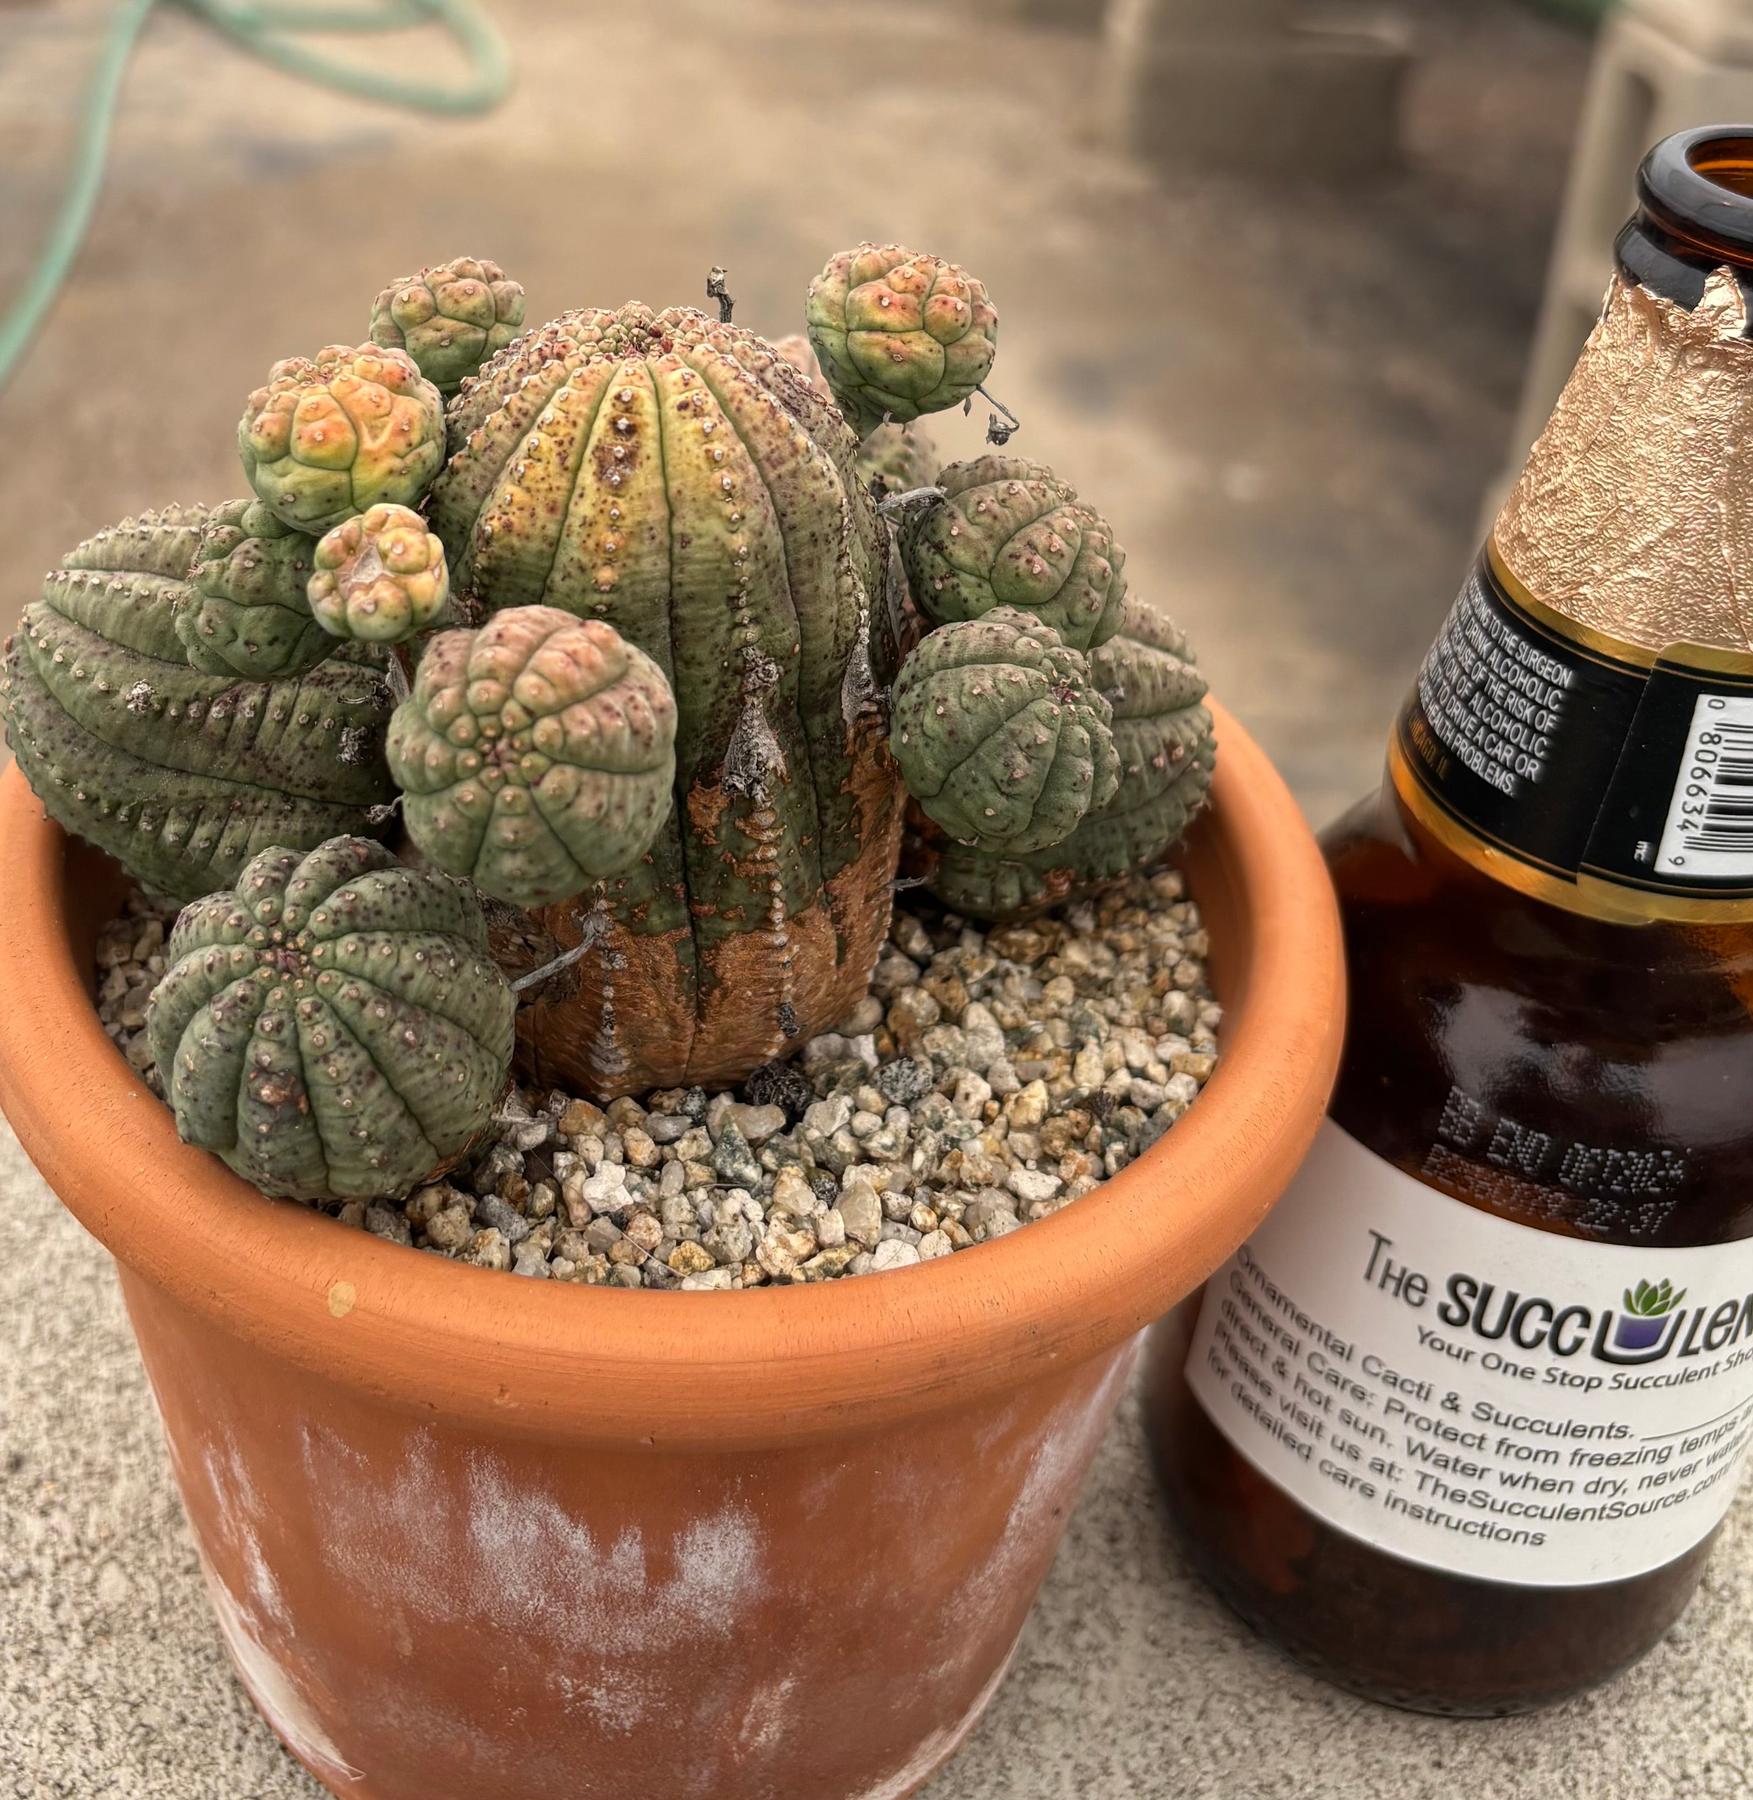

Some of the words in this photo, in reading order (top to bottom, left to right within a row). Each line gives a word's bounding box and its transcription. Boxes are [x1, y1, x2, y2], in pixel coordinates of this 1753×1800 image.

[1465, 616, 1493, 660] DRINK
[1485, 648, 1563, 711] ALCOHOLIC
[1471, 659, 1488, 684] OF
[1484, 672, 1508, 706] THE
[1504, 689, 1536, 725] RISK
[1534, 708, 1558, 733] OF
[1488, 614, 1501, 639] TO
[1498, 624, 1519, 653] THE
[1514, 641, 1574, 689] SURGEON
[1425, 698, 1456, 748] HEALTH
[1451, 732, 1516, 798] PROBLEMS.
[1436, 678, 1450, 707] TO
[1445, 694, 1480, 739] DRIVE
[1473, 725, 1485, 747] A
[1484, 732, 1514, 768] CAR
[1514, 753, 1540, 783] OR
[1456, 674, 1475, 701] OF
[1468, 690, 1549, 757] ALCOHOLIC
[1676, 731, 1723, 832] 806634
[1230, 1269, 1301, 1358] General
[1307, 1351, 1377, 1406] Care:
[1382, 1396, 1489, 1451] Protect
[1495, 1436, 1561, 1466] from
[1567, 1444, 1674, 1468] freezing
[1678, 1415, 1739, 1456] temps
[1236, 1243, 1354, 1362] Ornamental
[1361, 1353, 1435, 1402] Cacti
[1440, 1391, 1463, 1415] &
[1470, 1400, 1634, 1441] Succulents.
[1417, 1324, 1475, 1364] Your
[1481, 1350, 1537, 1382] One
[1542, 1365, 1603, 1394] Stop
[1607, 1361, 1721, 1390] Succulent
[1230, 1380, 1313, 1463] detailed
[1318, 1458, 1377, 1500] care
[1382, 1488, 1548, 1548] instructions
[1279, 1393, 1325, 1441] visit
[1330, 1434, 1363, 1462] us
[1369, 1455, 1405, 1483] at:
[1293, 1371, 1332, 1414] hot
[1338, 1407, 1395, 1449] sun.
[1405, 1436, 1493, 1482] Water
[1498, 1471, 1575, 1496] when
[1582, 1476, 1629, 1499] dry,
[1638, 1457, 1704, 1491] never
